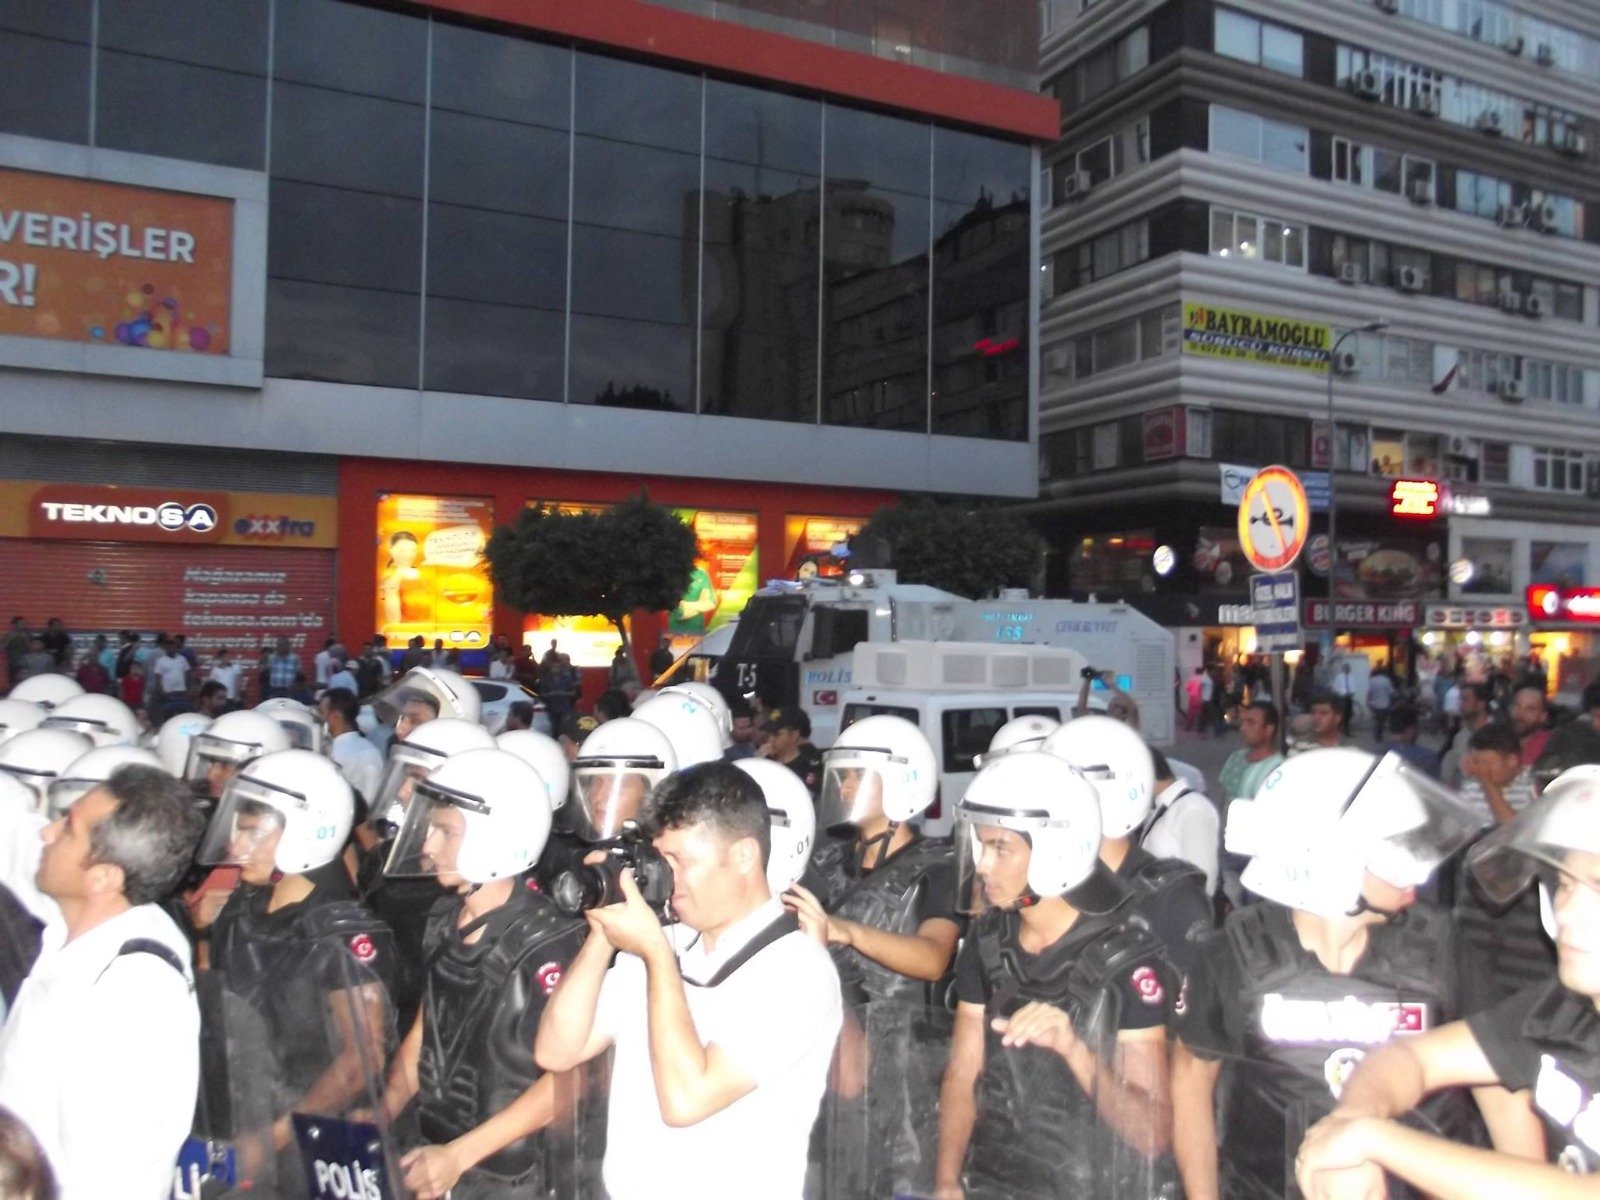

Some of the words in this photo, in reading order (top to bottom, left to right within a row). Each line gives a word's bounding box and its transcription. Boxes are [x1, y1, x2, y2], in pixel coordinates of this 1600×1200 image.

[41, 502, 216, 531] TEKNOSA
[1377, 604, 1416, 623] KING
[736, 662, 758, 688] T-5
[317, 824, 337, 840] 01
[795, 835, 810, 855] 01
[314, 1158, 381, 1200] POLİS
